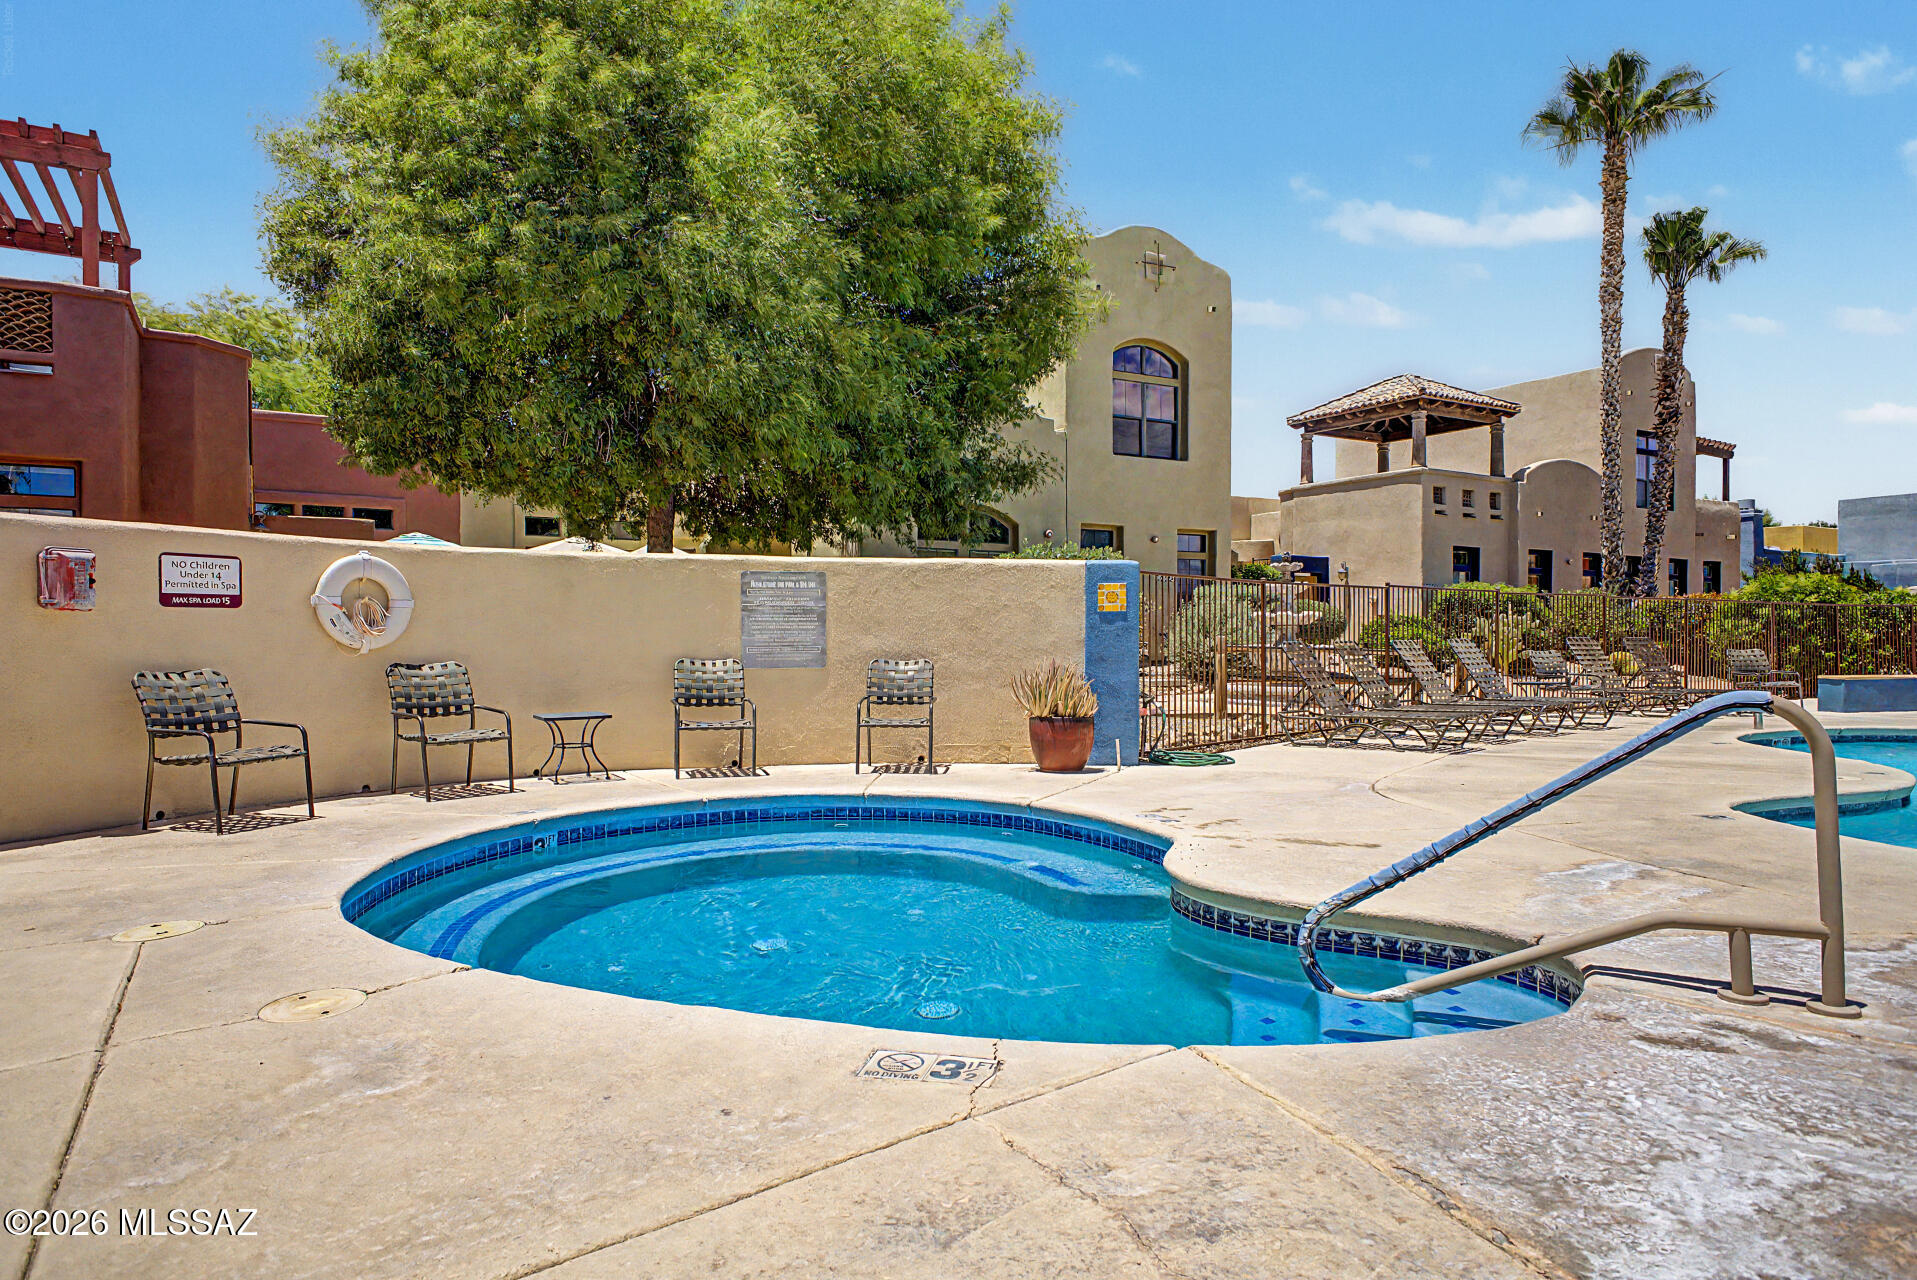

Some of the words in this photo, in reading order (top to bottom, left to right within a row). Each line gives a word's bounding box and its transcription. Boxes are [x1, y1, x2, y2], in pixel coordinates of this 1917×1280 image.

[171, 560, 187, 568] NO
[189, 561, 230, 571] Children
[180, 571, 208, 579] Under
[211, 572, 222, 581] 14
[165, 580, 209, 589] Permitted
[221, 581, 237, 591] Spa
[222, 597, 231, 605] 15
[929, 1059, 967, 1080] 3
[881, 1070, 920, 1080] DIVING
